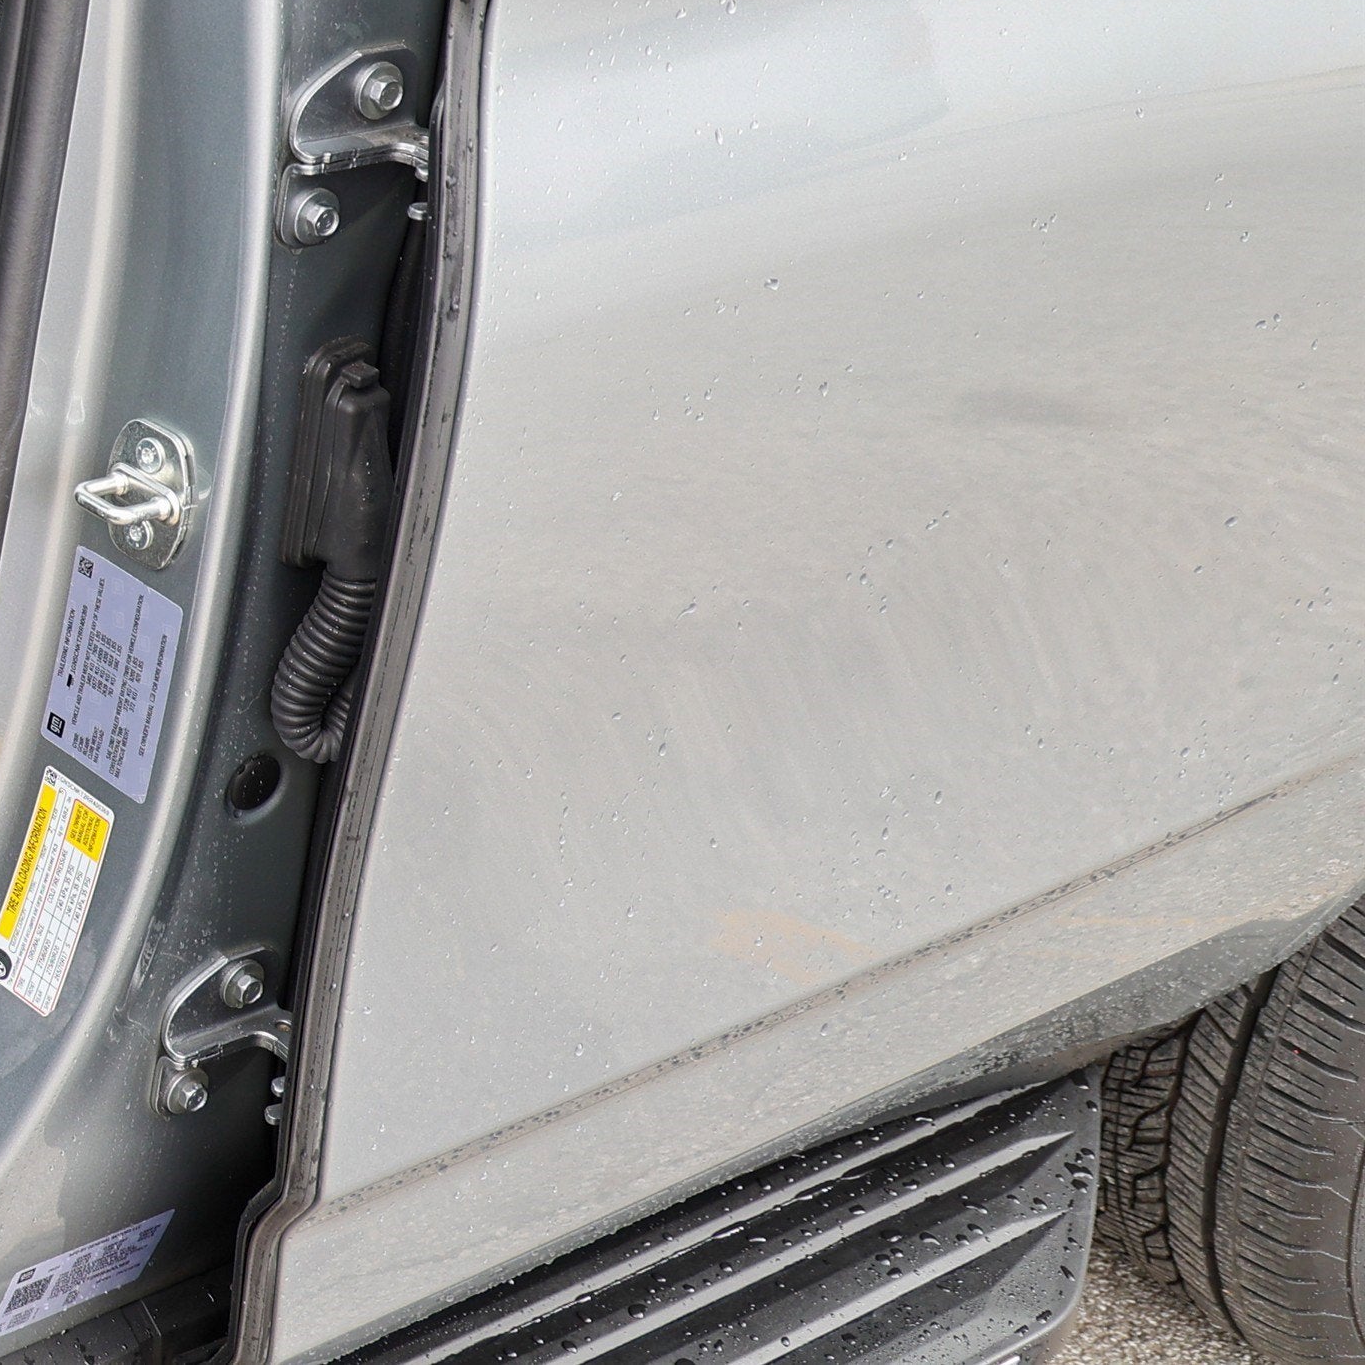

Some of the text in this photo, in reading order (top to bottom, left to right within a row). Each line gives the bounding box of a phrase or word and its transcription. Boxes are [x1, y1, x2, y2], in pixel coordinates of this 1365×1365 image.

[93, 596, 101, 614] THESE
[92, 612, 98, 621] OF
[57, 607, 76, 678] TRAILERING INFORMATION
[86, 630, 94, 651] EXCEED
[156, 633, 168, 668] INFORMATION
[77, 673, 86, 695] TRAILER
[111, 714, 119, 736] TRAILER
[115, 695, 123, 716] WEIGHT
[127, 632, 136, 654] VEHICLE
[153, 666, 161, 682] MORE
[50, 714, 62, 734] gm
[71, 704, 79, 726] VEHICLE
[108, 736, 121, 775] CONVENTIONAL
[116, 746, 125, 767] TONGUE
[69, 827, 77, 840] SEE
[75, 808, 89, 843] MANUAL FOR
[81, 814, 95, 846] ADDITIONAL
[86, 816, 101, 852] INFORMATION
[6, 805, 48, 915] TIRE AND LOADING INFORMATION
